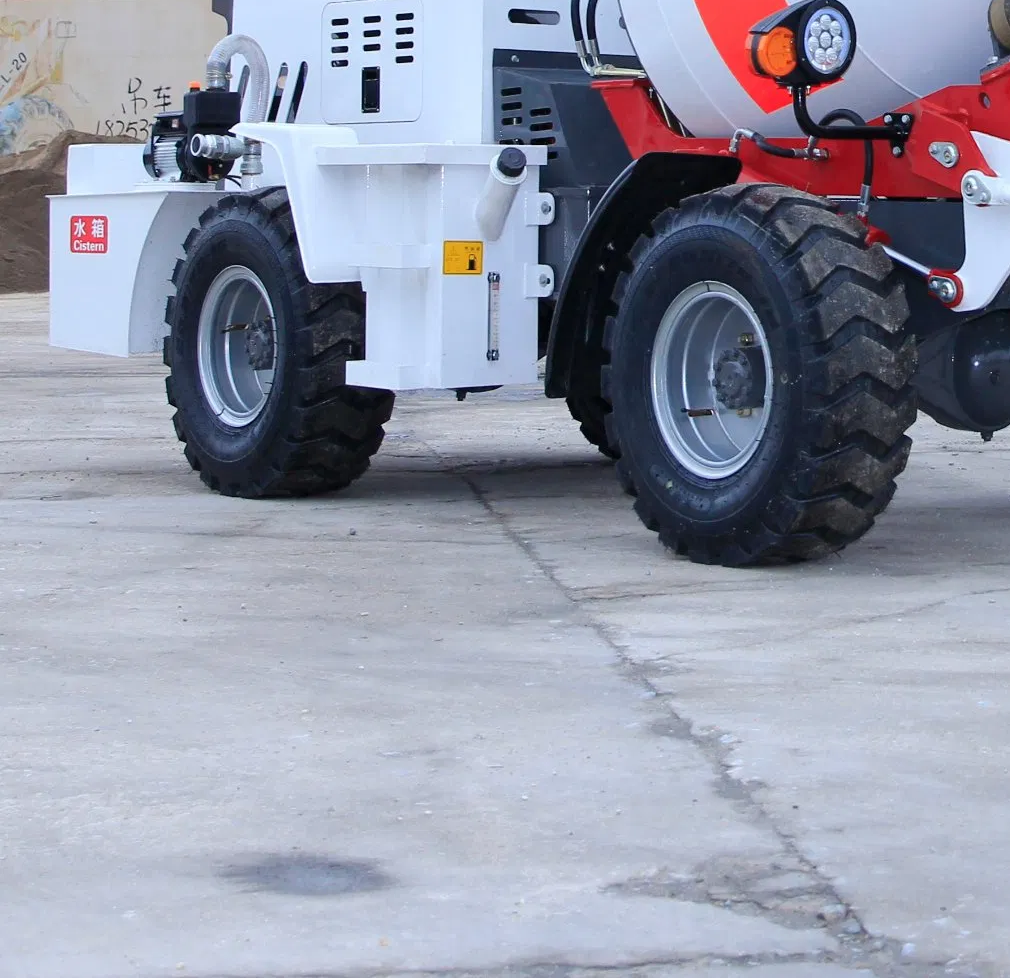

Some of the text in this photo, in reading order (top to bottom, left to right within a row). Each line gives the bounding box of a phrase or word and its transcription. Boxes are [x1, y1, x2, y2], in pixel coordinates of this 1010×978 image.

[0, 52, 27, 90] L-20
[121, 77, 172, 115] 吊车
[96, 119, 153, 142] 18253
[73, 218, 105, 238] 水箱
[73, 239, 105, 252] Cistern
